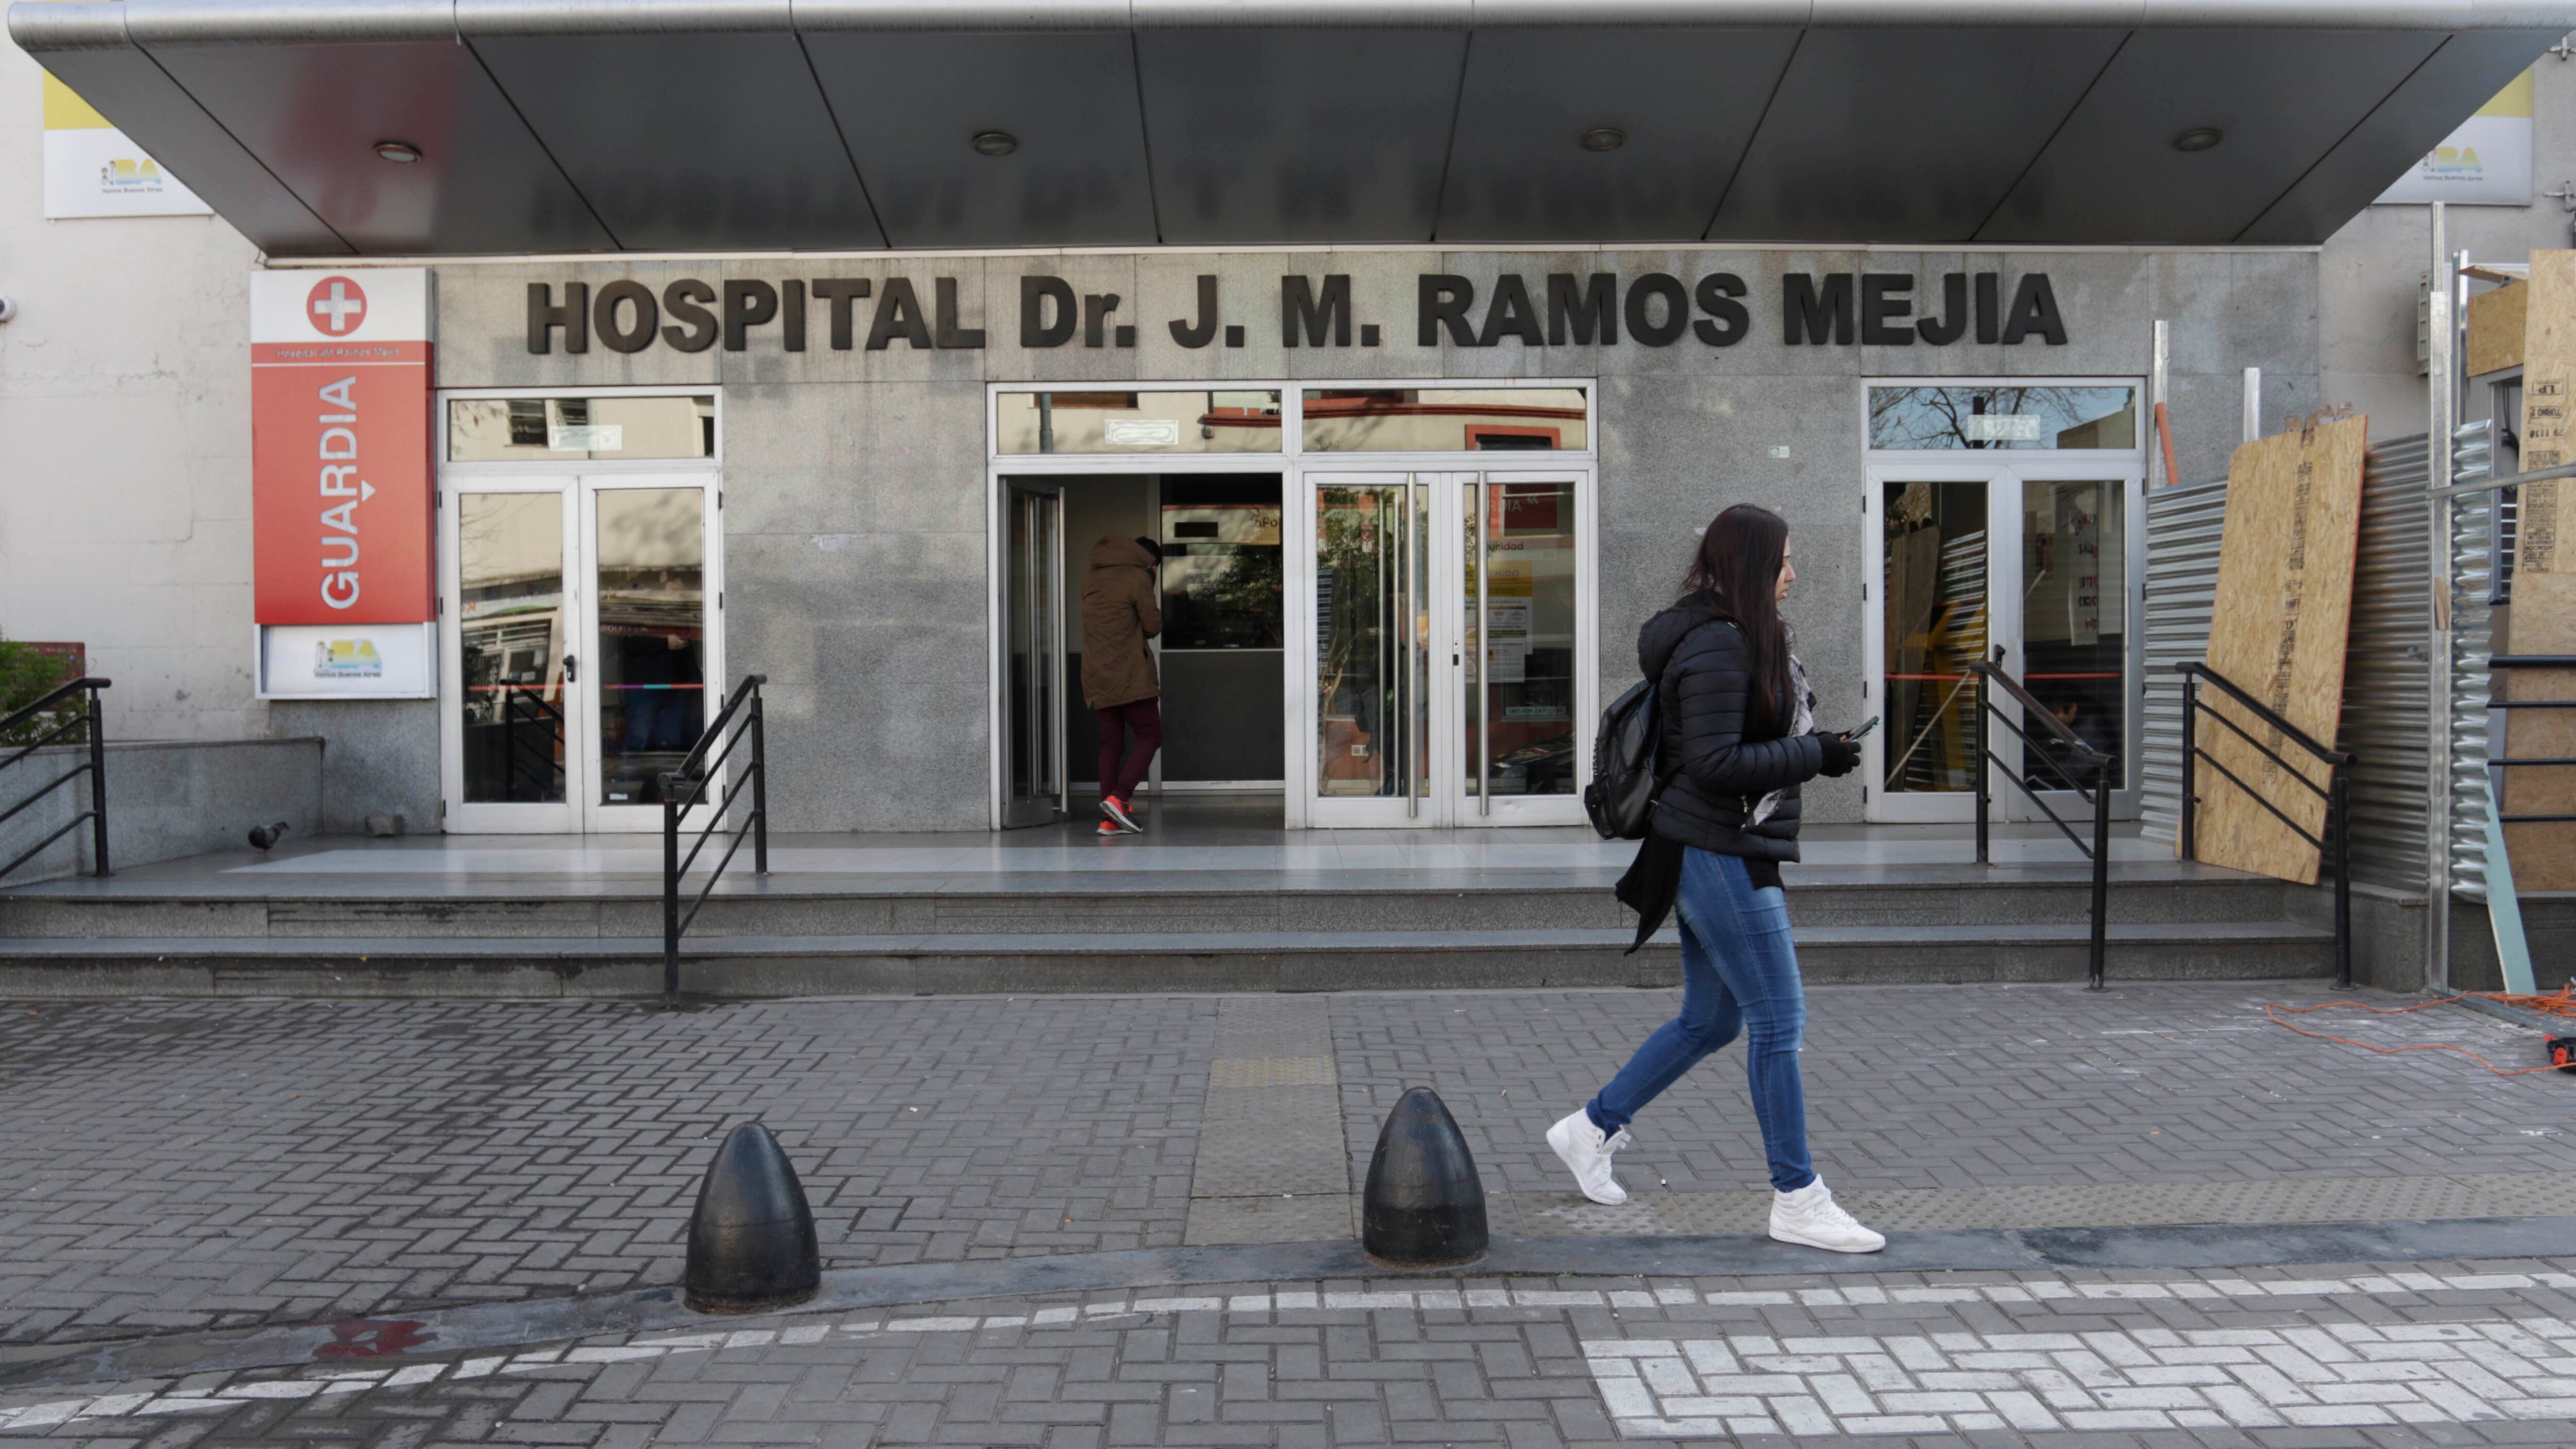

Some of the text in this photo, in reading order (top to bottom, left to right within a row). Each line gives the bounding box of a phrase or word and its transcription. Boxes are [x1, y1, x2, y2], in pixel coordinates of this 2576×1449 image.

[277, 349, 316, 358] Hospital
[527, 272, 2067, 354] HOSPITAL Dr. J. M. RAMOS MEJIA
[318, 376, 360, 609] GUARDIA
